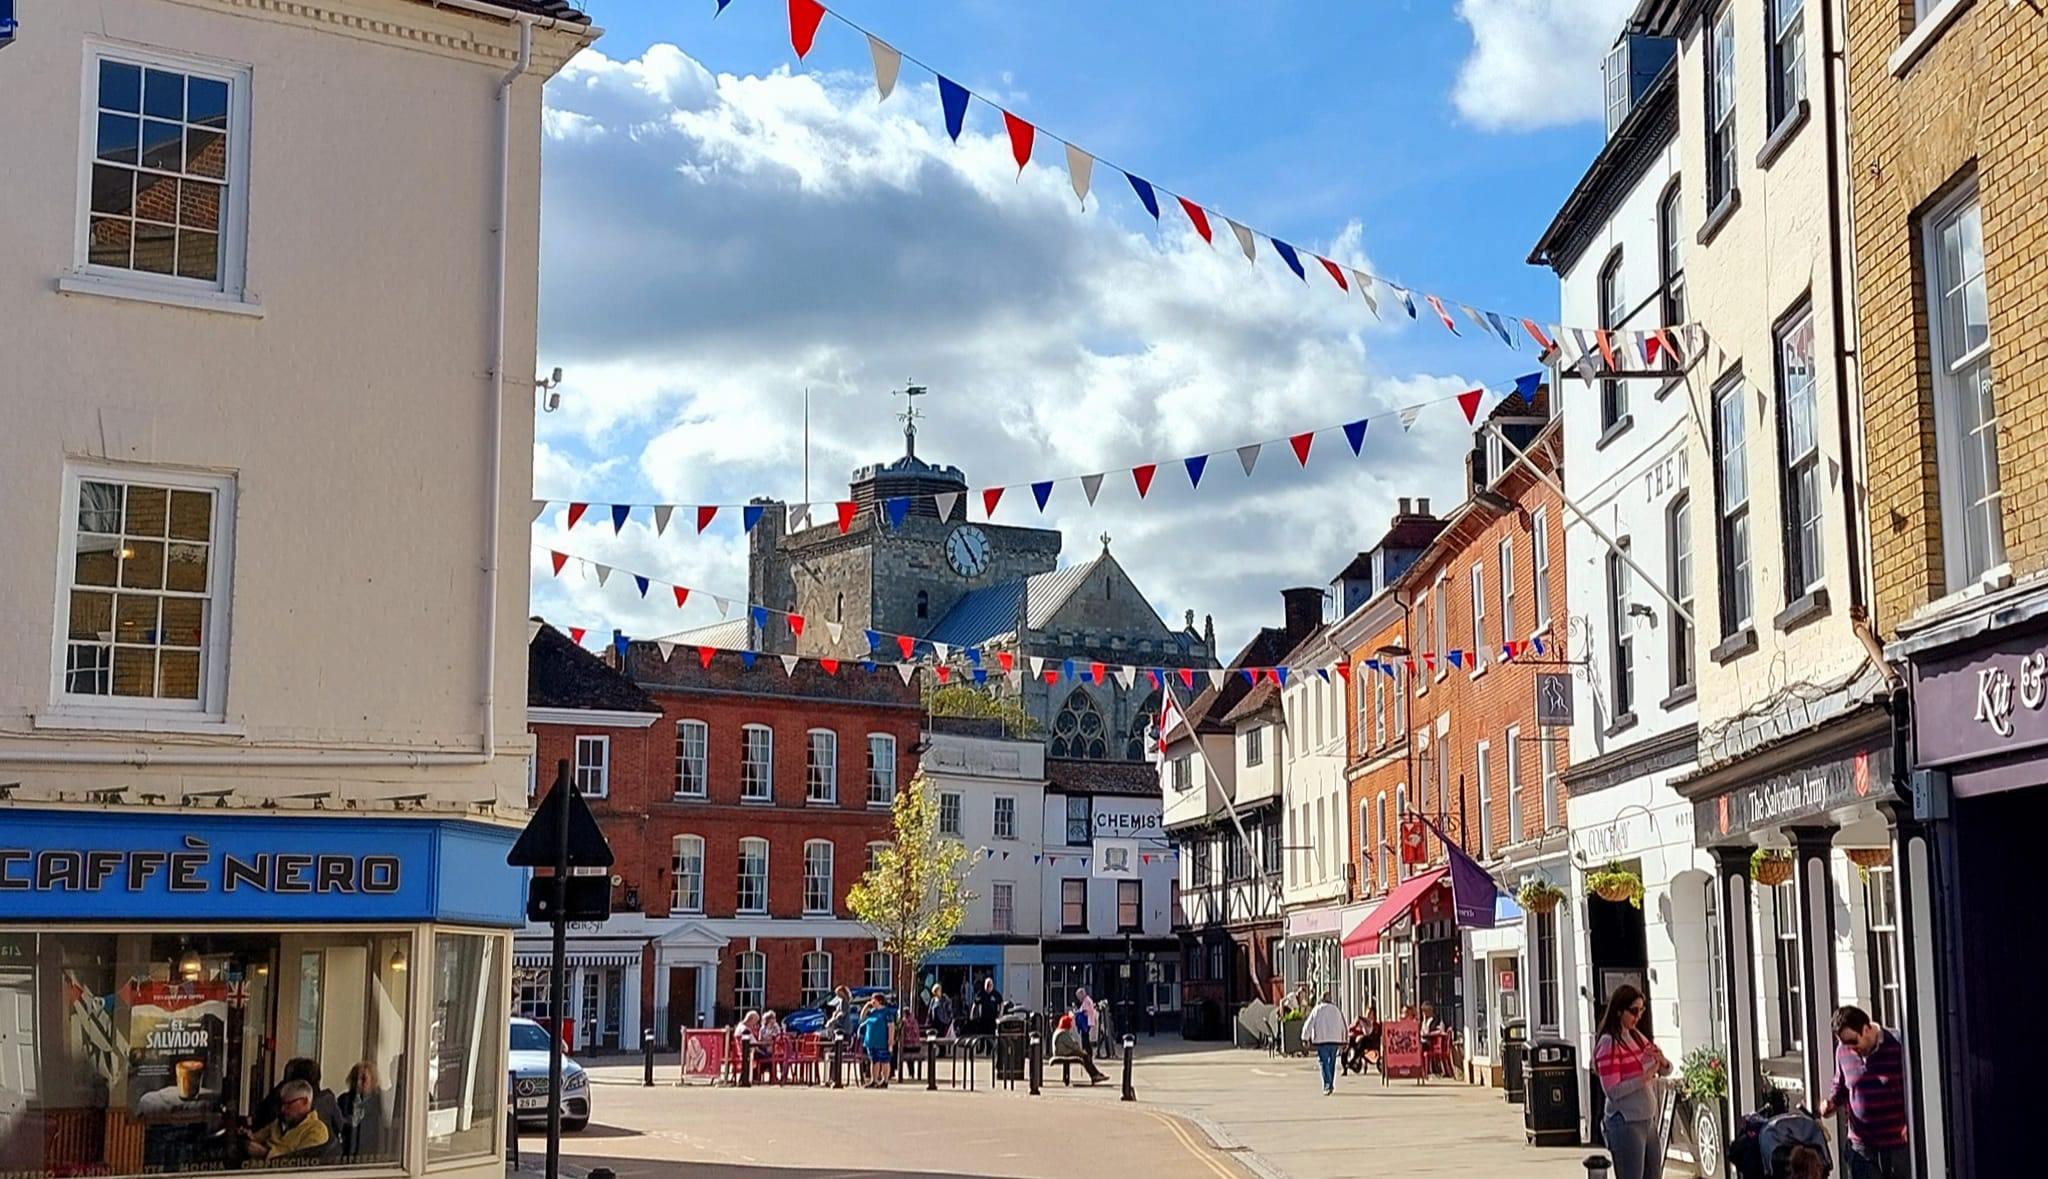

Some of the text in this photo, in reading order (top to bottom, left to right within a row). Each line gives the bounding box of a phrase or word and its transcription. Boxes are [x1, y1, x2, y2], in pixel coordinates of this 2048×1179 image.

[1645, 457, 1673, 504] THE
[1974, 666, 2012, 736] Kit
[1096, 812, 1163, 829] CHEMIST
[1748, 772, 1827, 823] The Salvation Army
[0, 834, 401, 894] CAFFÈ NERO
[146, 1031, 209, 1049] SALVADOR
[171, 1019, 185, 1031] EL
